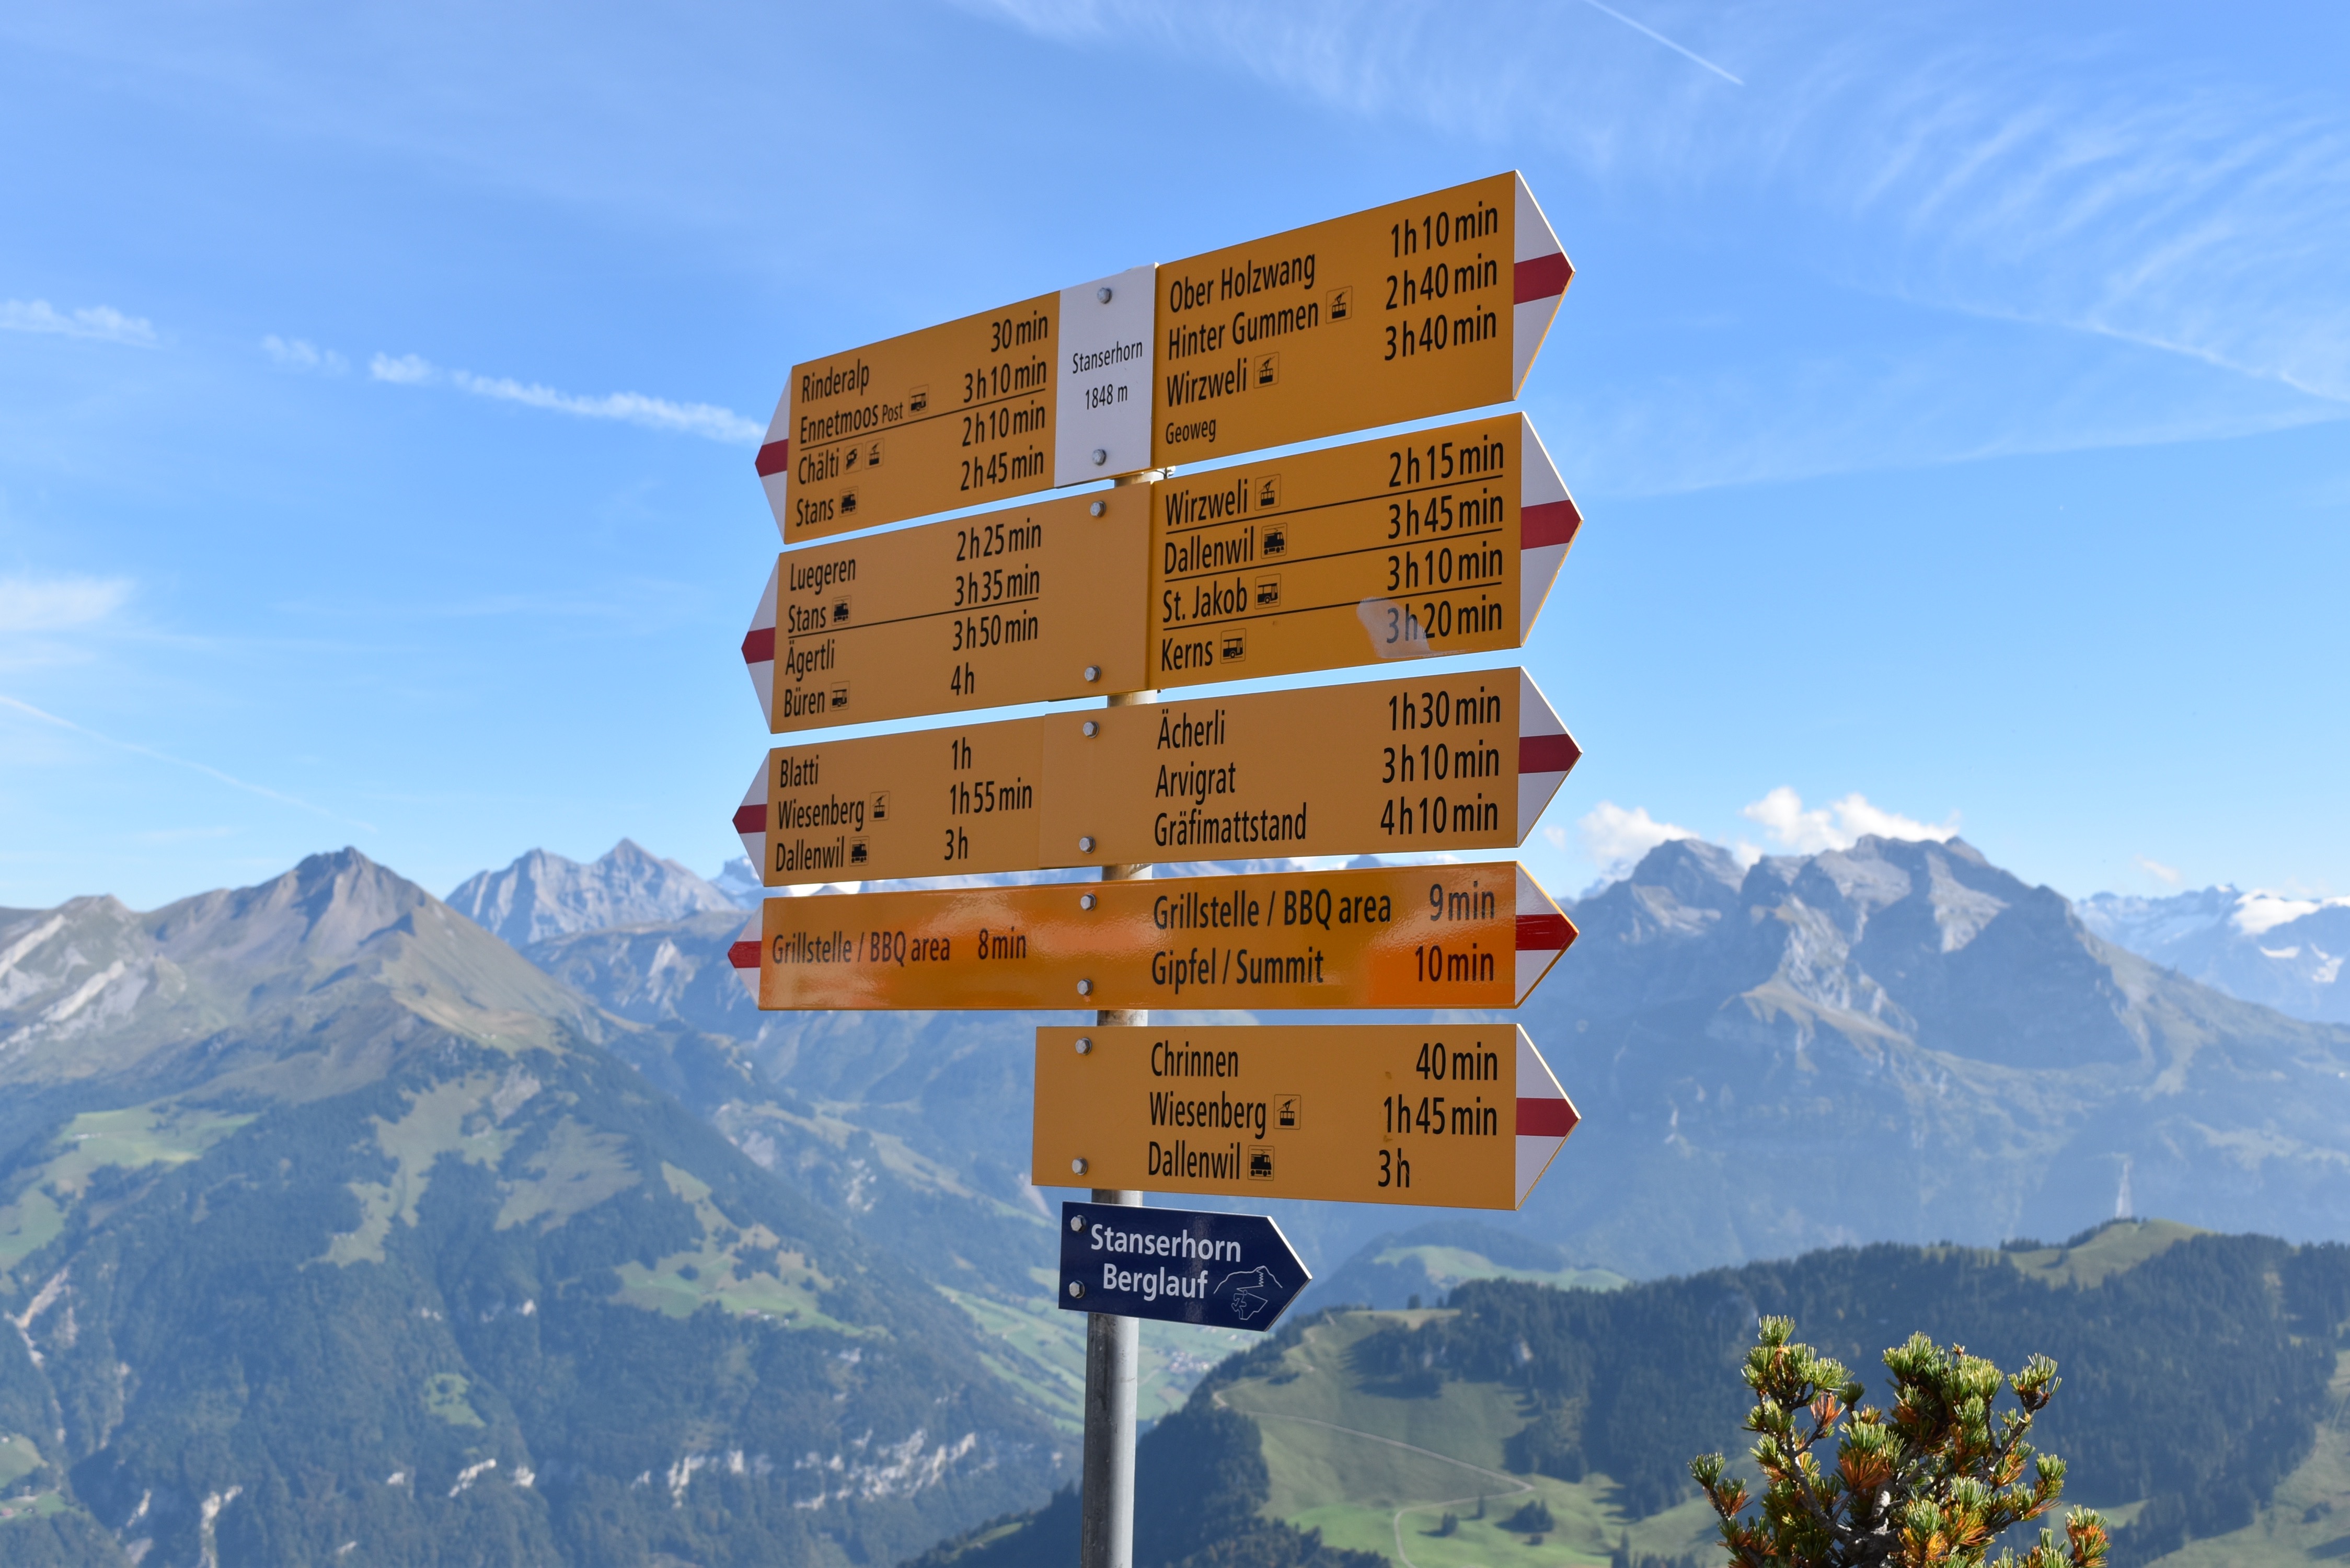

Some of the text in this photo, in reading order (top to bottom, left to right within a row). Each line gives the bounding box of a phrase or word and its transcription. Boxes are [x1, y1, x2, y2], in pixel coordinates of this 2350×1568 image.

[1170, 276, 1214, 313] Ober
[1221, 253, 1316, 301] Holzwang
[1168, 324, 1226, 361] Hinter
[1232, 302, 1319, 345] Gummen
[1072, 341, 1143, 374] Stanserhorn
[802, 359, 869, 402] Rinderalp
[1085, 384, 1128, 410] 1848 m
[1167, 357, 1247, 408] Wirzweli
[800, 404, 879, 444] Ennetmoos
[882, 402, 903, 423] Post
[1165, 419, 1216, 445] Geoweg
[798, 447, 839, 485] Chälti
[796, 498, 834, 527] Stans
[1165, 478, 1248, 526] Wirzweli
[1164, 525, 1254, 575] Dallenwil
[790, 559, 856, 596] Luegeren
[788, 604, 826, 633] Stans
[1162, 589, 1186, 623] St.
[1192, 577, 1248, 619] Jakob
[785, 639, 835, 683] Ägertli
[1161, 637, 1213, 672] Kerns
[784, 687, 825, 718] Büren
[1157, 708, 1225, 750] Ächerli
[780, 754, 819, 788] Blatti
[1155, 760, 1236, 806] Arvigrat
[778, 794, 865, 832] Wiesenberg
[1154, 802, 1307, 847] Gräfimattstand
[775, 835, 845, 872] Dallenwil
[1153, 890, 1260, 930] Grillstelle
[1284, 888, 1332, 931] BBQ
[1338, 895, 1391, 924] area
[773, 930, 851, 964] Grillstelle
[870, 930, 906, 967] BBQ
[911, 938, 950, 962] area
[1151, 947, 1216, 995] Gipfel
[1236, 946, 1324, 985] Summit
[1151, 1040, 1239, 1078] Chrinnen
[1149, 1090, 1266, 1140] Wiesenberg
[1148, 1139, 1240, 1180] Dallenwil
[1091, 1224, 1241, 1262] Stanserhorn
[1103, 1263, 1208, 1301] Berglauf
